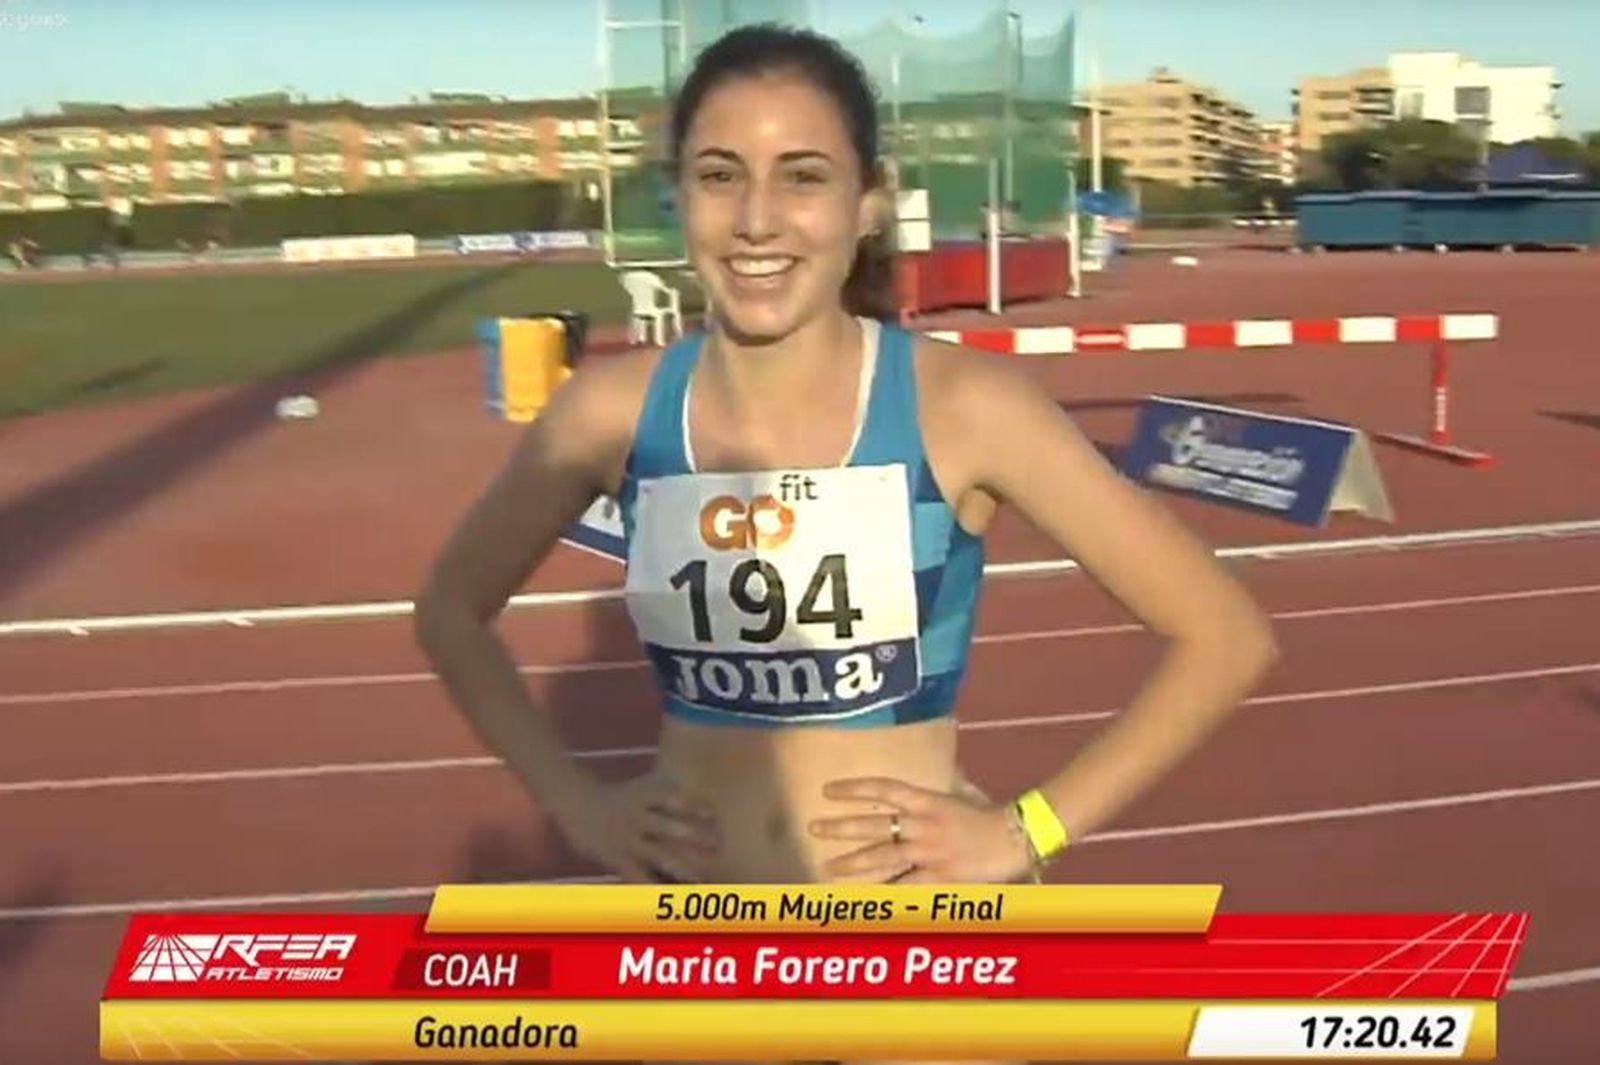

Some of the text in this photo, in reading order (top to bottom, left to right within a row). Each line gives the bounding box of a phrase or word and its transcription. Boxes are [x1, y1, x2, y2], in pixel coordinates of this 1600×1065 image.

[699, 474, 819, 551] GO fit
[669, 553, 864, 644] 194
[669, 651, 884, 706] Joma
